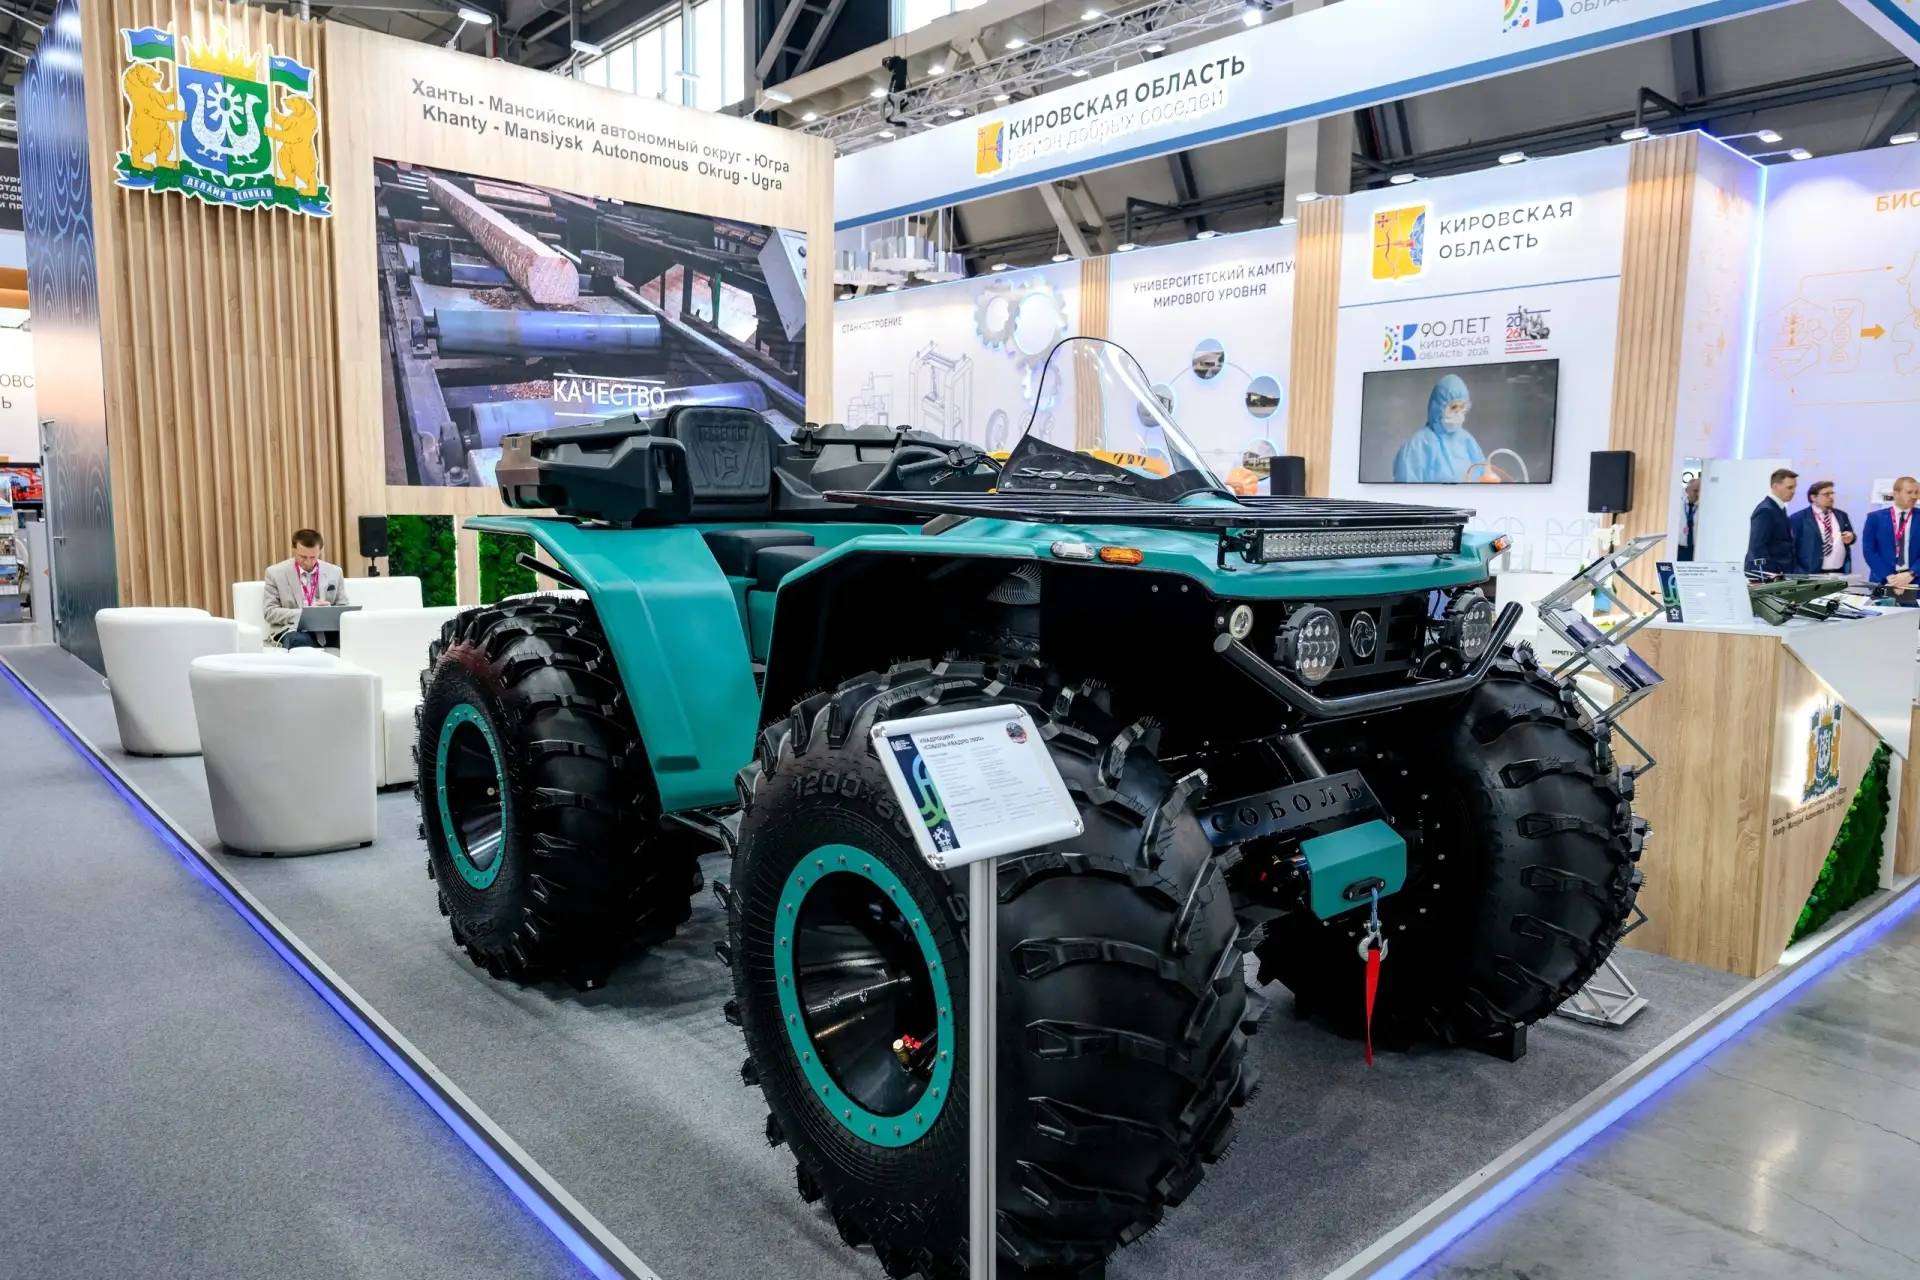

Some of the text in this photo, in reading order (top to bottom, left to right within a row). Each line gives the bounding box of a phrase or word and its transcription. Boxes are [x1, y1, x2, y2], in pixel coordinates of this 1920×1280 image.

[1009, 55, 1246, 140] КИРОВСКАЯ ОБЛАСТЬ
[412, 77, 473, 106] Ханты
[489, 95, 595, 133] Мансийский
[600, 123, 698, 154] автономный
[703, 146, 742, 164] округ
[755, 153, 789, 173] Югра
[423, 103, 487, 135] Khanty
[505, 121, 583, 151] Mansiysk
[592, 140, 689, 172] Autonomous
[698, 161, 740, 186] Okrug
[752, 172, 782, 190] Ugra
[186, 177, 226, 199] ДЕЛАМИ
[1440, 201, 1573, 235] КИРОВСКАЯ
[1439, 233, 1538, 259] ОБЛАСТЬ
[1133, 260, 1296, 294] УНИВЕРСИТЕТСКИЙ КАМПУ
[1153, 283, 1267, 308] МИРОВОГО УРОВНЯ
[1421, 316, 1491, 337] 90 ЛЕТ
[1419, 349, 1489, 360] ОБЛАСТЬ 2026
[1420, 335, 1490, 349] КИРОВСКАЯ
[553, 379, 665, 408] КАЧЕСТВО
[1210, 782, 1362, 834] СОБОЛЬ
